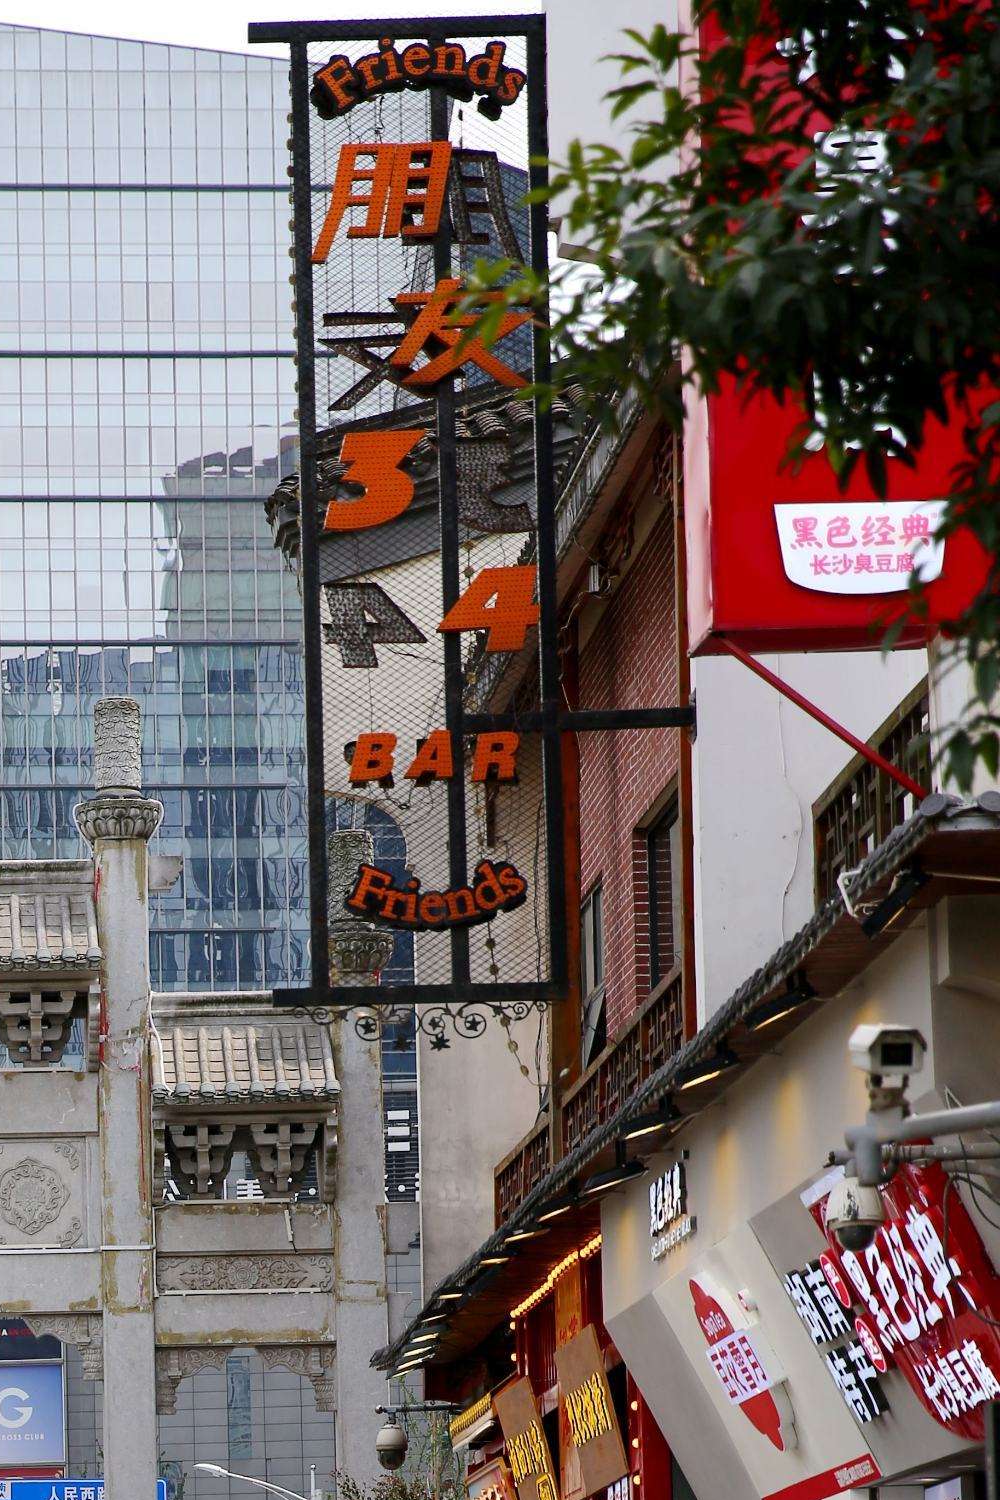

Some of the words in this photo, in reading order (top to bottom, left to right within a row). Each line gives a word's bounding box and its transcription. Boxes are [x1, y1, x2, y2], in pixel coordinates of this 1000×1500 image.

[316, 36, 526, 110] Friends
[790, 513, 936, 549] 黑色经典
[811, 553, 915, 576] 长沙臭豆腐
[348, 729, 520, 782] BAR
[347, 862, 526, 924] Friends
[840, 1204, 977, 1354] 黑色经典
[913, 1339, 1000, 1422] 长沙臭豆腐
